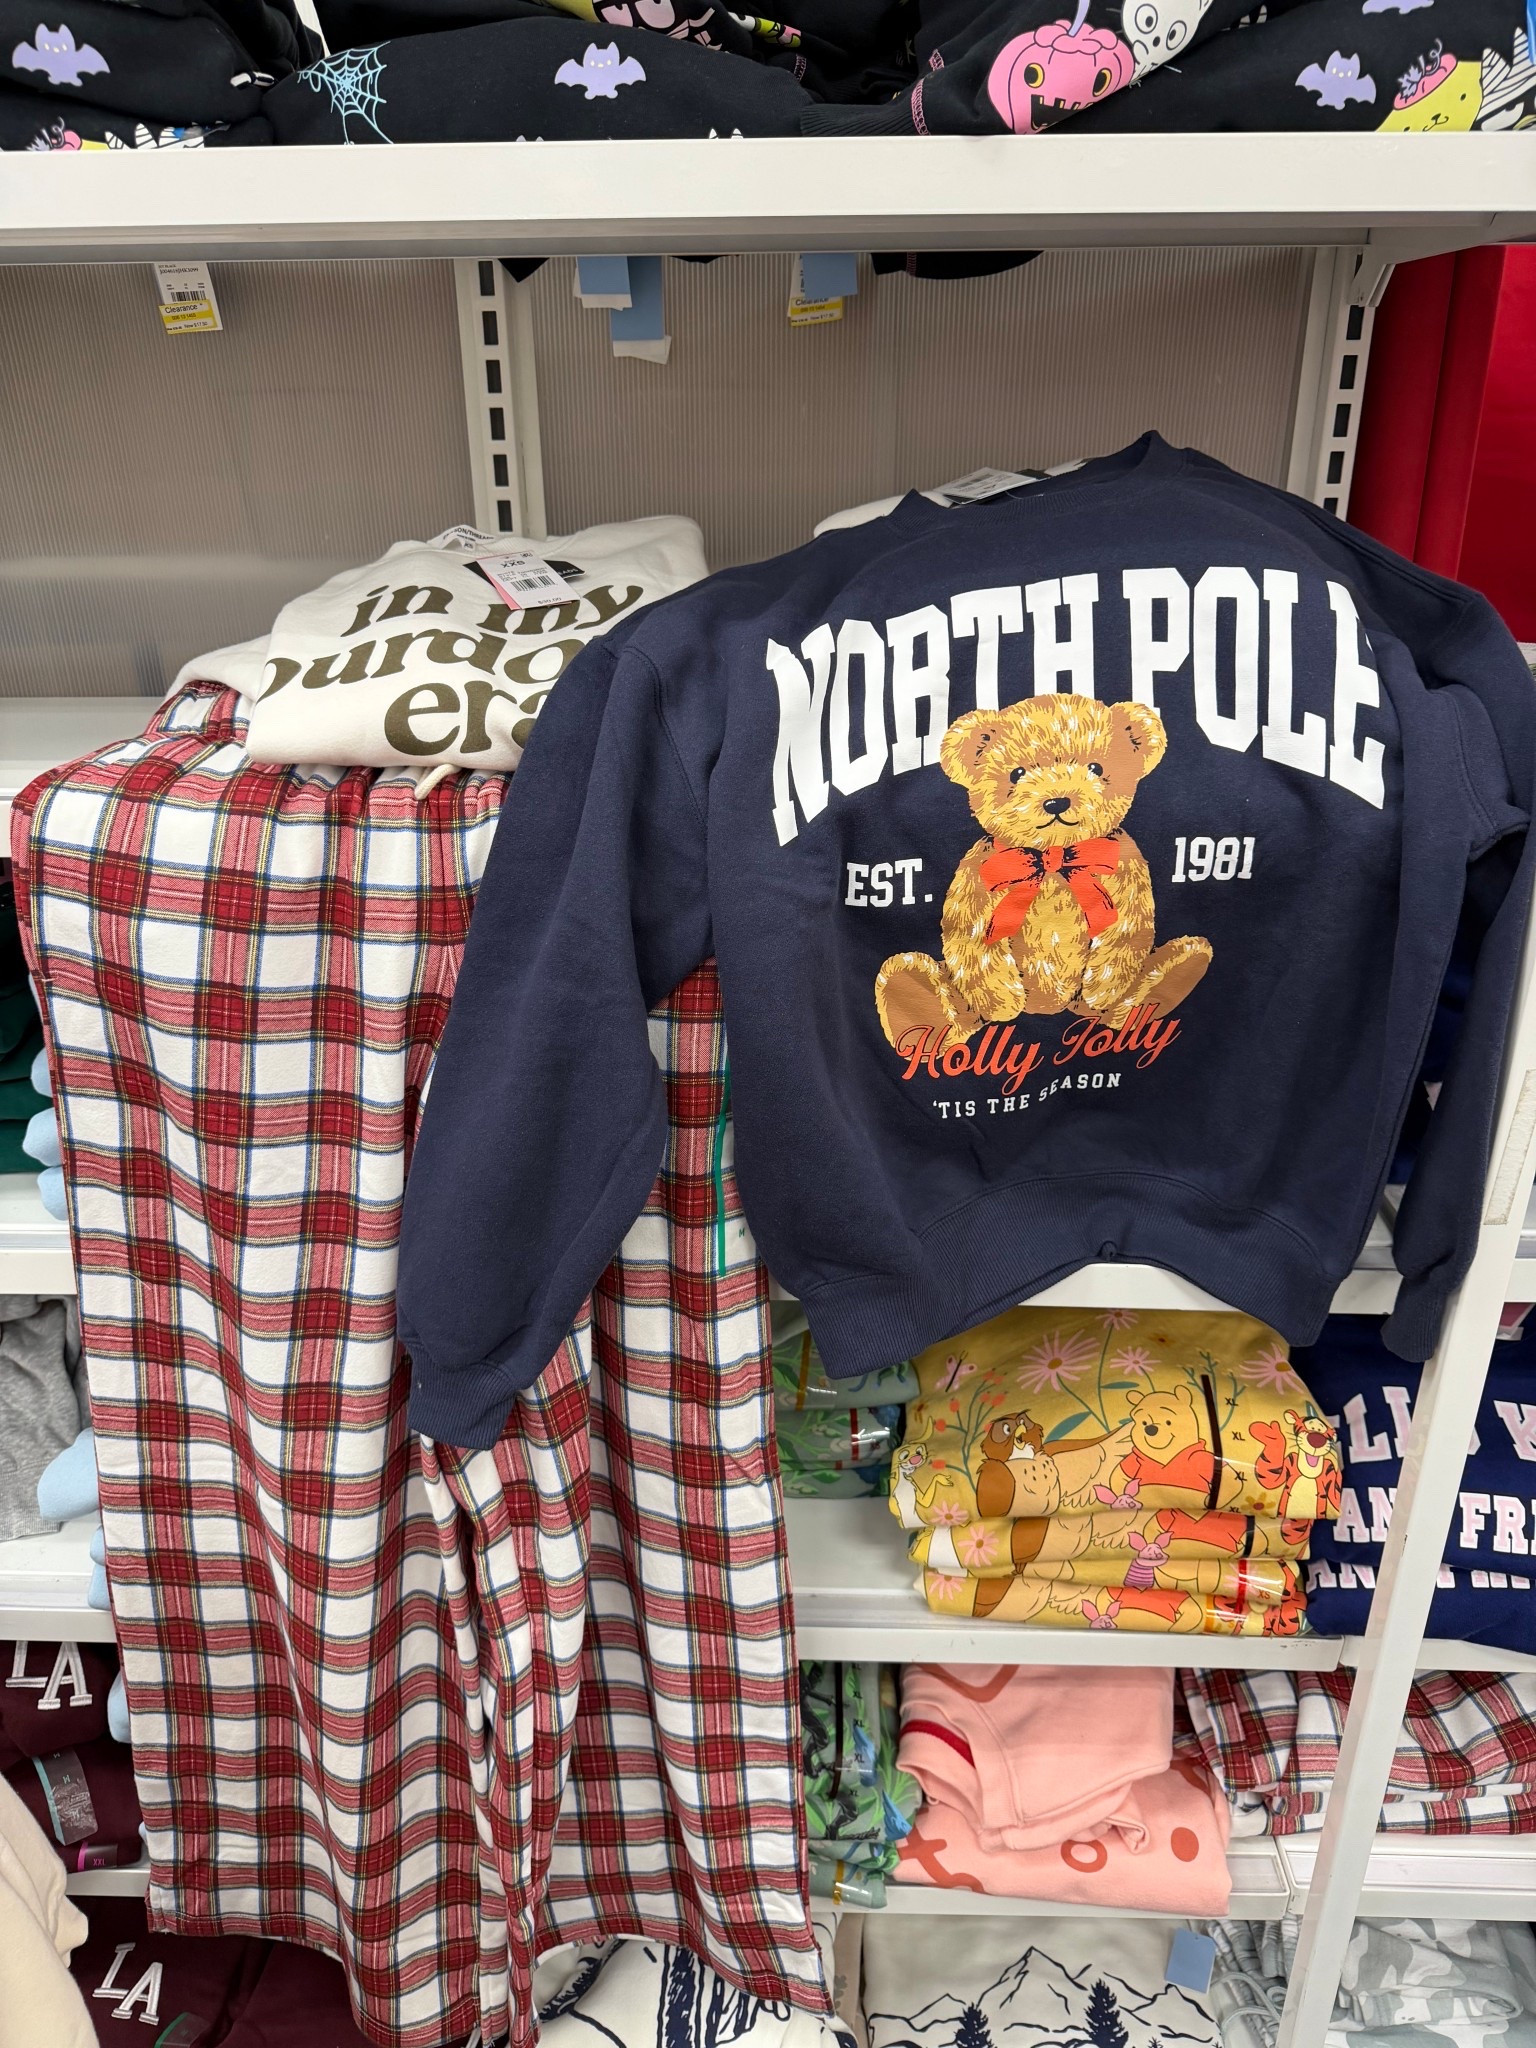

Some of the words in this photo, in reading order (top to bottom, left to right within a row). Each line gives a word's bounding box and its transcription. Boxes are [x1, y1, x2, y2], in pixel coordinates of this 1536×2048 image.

[165, 304, 198, 314] Clearance
[340, 585, 454, 637] in
[476, 585, 643, 634] my
[766, 572, 1101, 847] NORTH
[1122, 566, 1386, 811] POLE
[1171, 836, 1256, 883] 1981
[845, 858, 933, 908] EST.
[894, 1024, 1045, 1097] Holly
[1053, 1002, 1183, 1070] Jolly
[987, 1093, 1030, 1115] THE
[1039, 1072, 1123, 1102] SEASON
[738, 1227, 745, 1238] M
[1225, 1397, 1239, 1407] XL
[1232, 1431, 1246, 1441] XL
[1234, 1472, 1247, 1482] XL
[1258, 1590, 1271, 1600] XS
[6, 1641, 93, 1711] LA
[852, 1691, 862, 1699] XL
[854, 1718, 864, 1728] XL
[854, 1753, 864, 1763] XL
[849, 1789, 859, 1797] XL
[92, 1942, 163, 2026] LA
